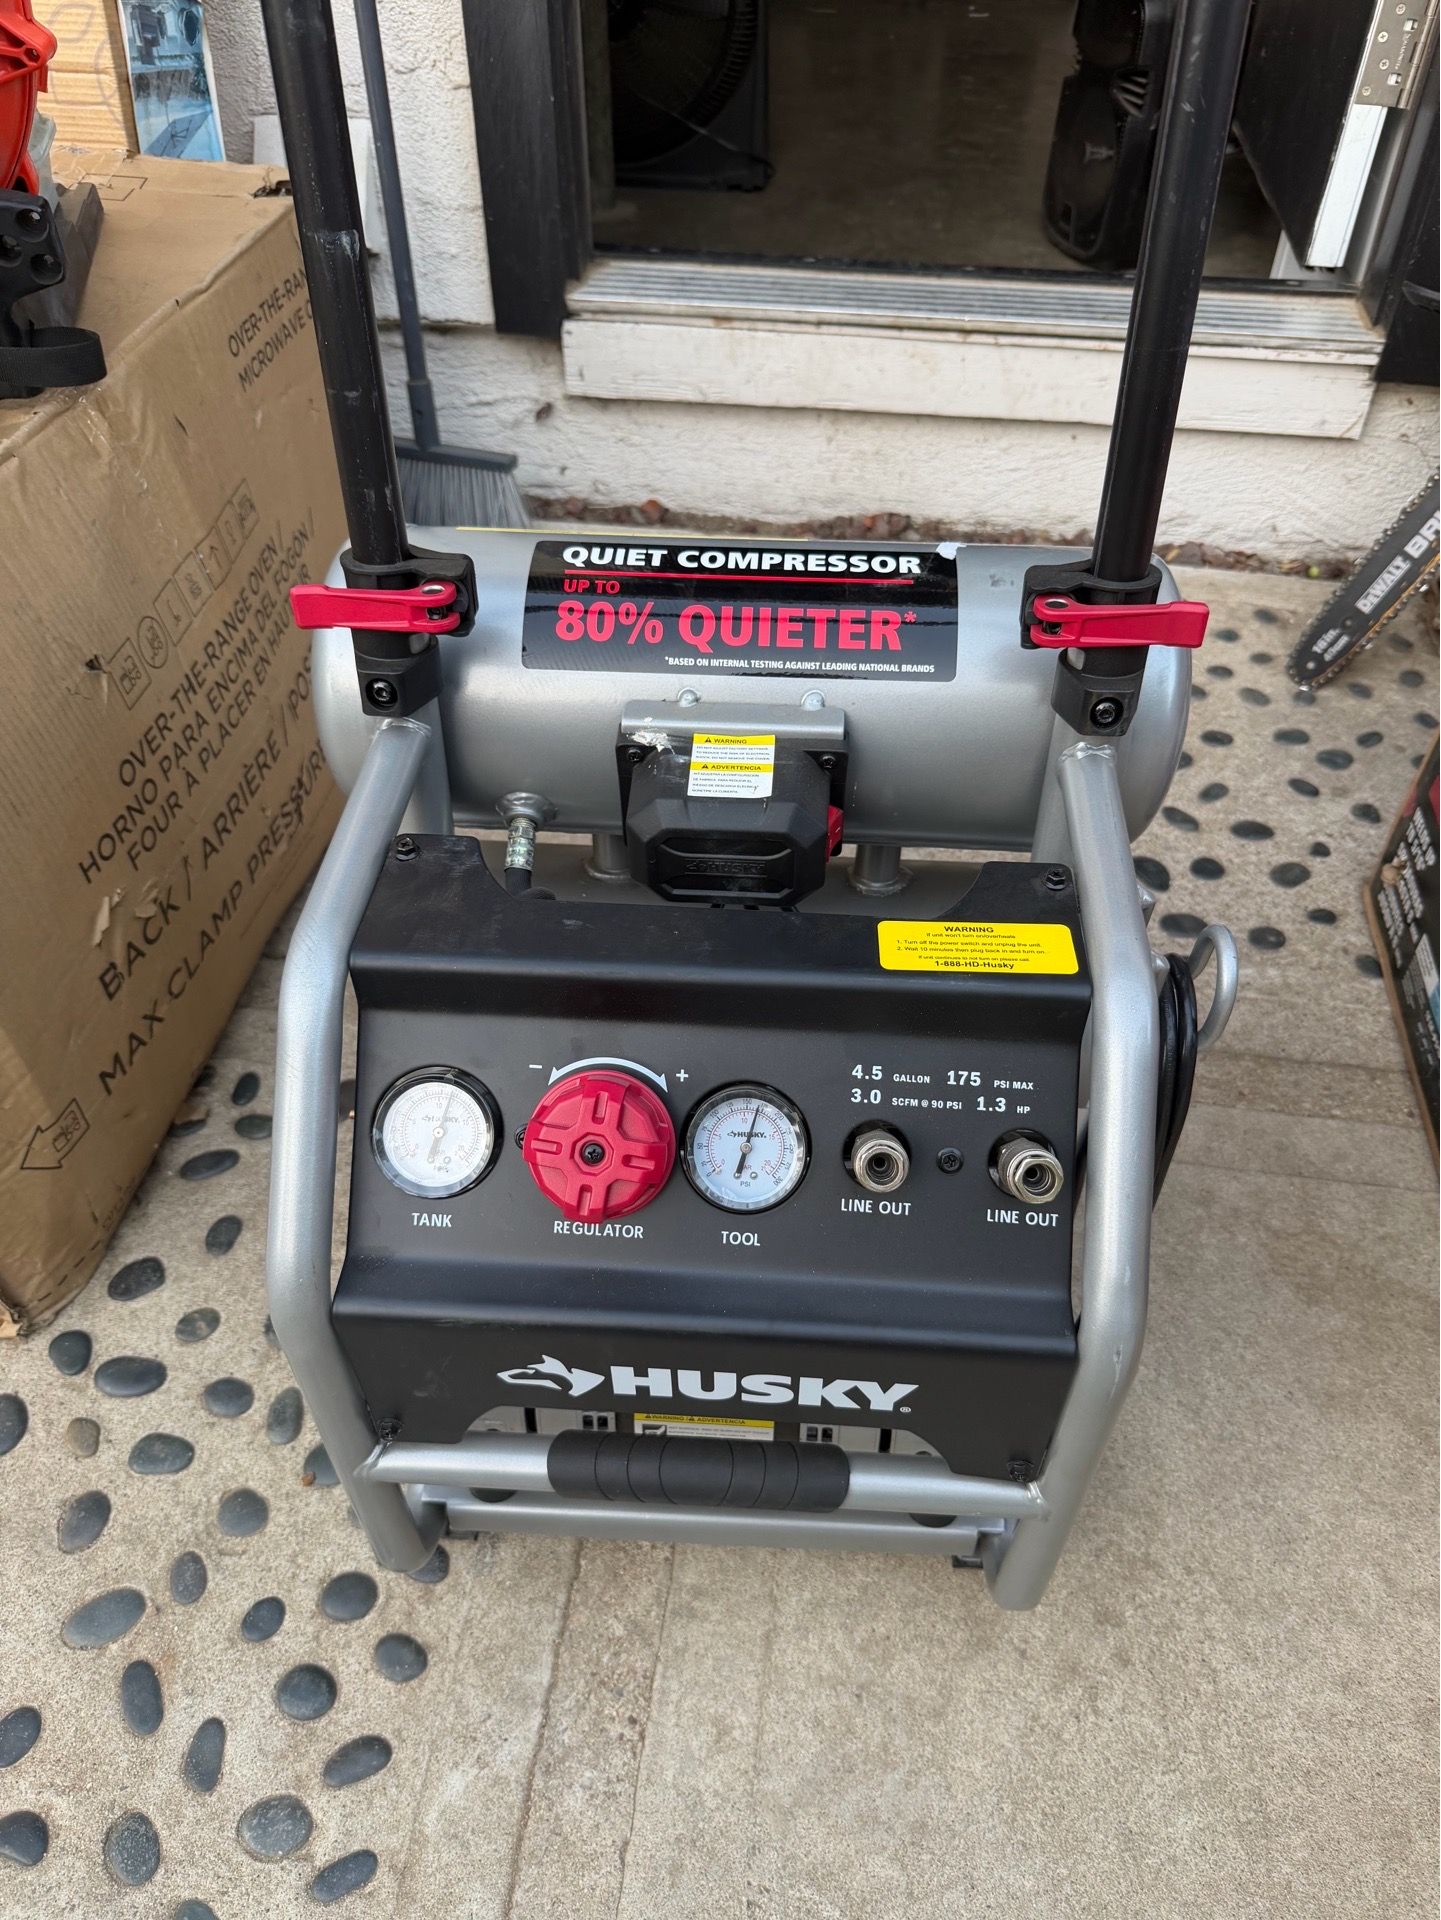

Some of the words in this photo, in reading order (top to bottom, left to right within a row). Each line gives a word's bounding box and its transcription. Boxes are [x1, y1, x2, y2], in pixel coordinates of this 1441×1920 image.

[228, 267, 307, 357] OVER-THE-RAN
[238, 307, 306, 392] MICROWAVE
[1404, 510, 1440, 558] BR
[562, 545, 668, 569] QUIET
[677, 549, 922, 575] COMPRESSOR
[563, 578, 590, 593] UP
[594, 579, 620, 594] TO
[554, 600, 664, 645] 80%
[119, 587, 253, 787] OVER-THE-RANGE
[249, 536, 278, 597] OVEN
[696, 657, 709, 666] ON
[710, 658, 749, 668] INTERNAL
[751, 660, 784, 669] TESTING
[785, 661, 820, 670] AGAINST
[821, 662, 857, 671] LEADING
[858, 663, 900, 672] NATIONAL
[901, 664, 935, 673] BRANDS
[78, 778, 158, 884] HORNO
[159, 710, 210, 783] PARA
[206, 627, 259, 714] ENCIMA
[255, 589, 277, 634] DEL
[127, 791, 184, 872] FOUR
[182, 766, 200, 798] À
[197, 679, 256, 774] PLACER
[253, 649, 272, 687] EN
[98, 885, 181, 1001] BACK
[201, 729, 281, 872] ARRIÈRE
[935, 960, 1015, 969] 1-888-HD-Husky
[99, 999, 165, 1097] MAX
[168, 879, 243, 1000] CLAMP
[851, 1064, 883, 1081] 4.5
[893, 1073, 931, 1084] GALLON
[947, 1070, 981, 1087] 175
[993, 1079, 1010, 1089] PSI
[1012, 1080, 1034, 1090] MAX
[850, 1088, 882, 1104] 3.0
[892, 1097, 919, 1108] SCFM
[931, 1099, 944, 1109] 90
[946, 1100, 962, 1110] PSI
[976, 1096, 1006, 1113] 1.3
[1017, 1105, 1031, 1114] HP
[411, 1212, 452, 1228] TANK
[841, 1198, 873, 1213] LINE
[878, 1201, 911, 1216] OUT
[986, 1209, 1019, 1224] LINE
[1025, 1211, 1058, 1227] OUT
[553, 1220, 644, 1239] REGULATOR
[721, 1231, 761, 1247] TOOL
